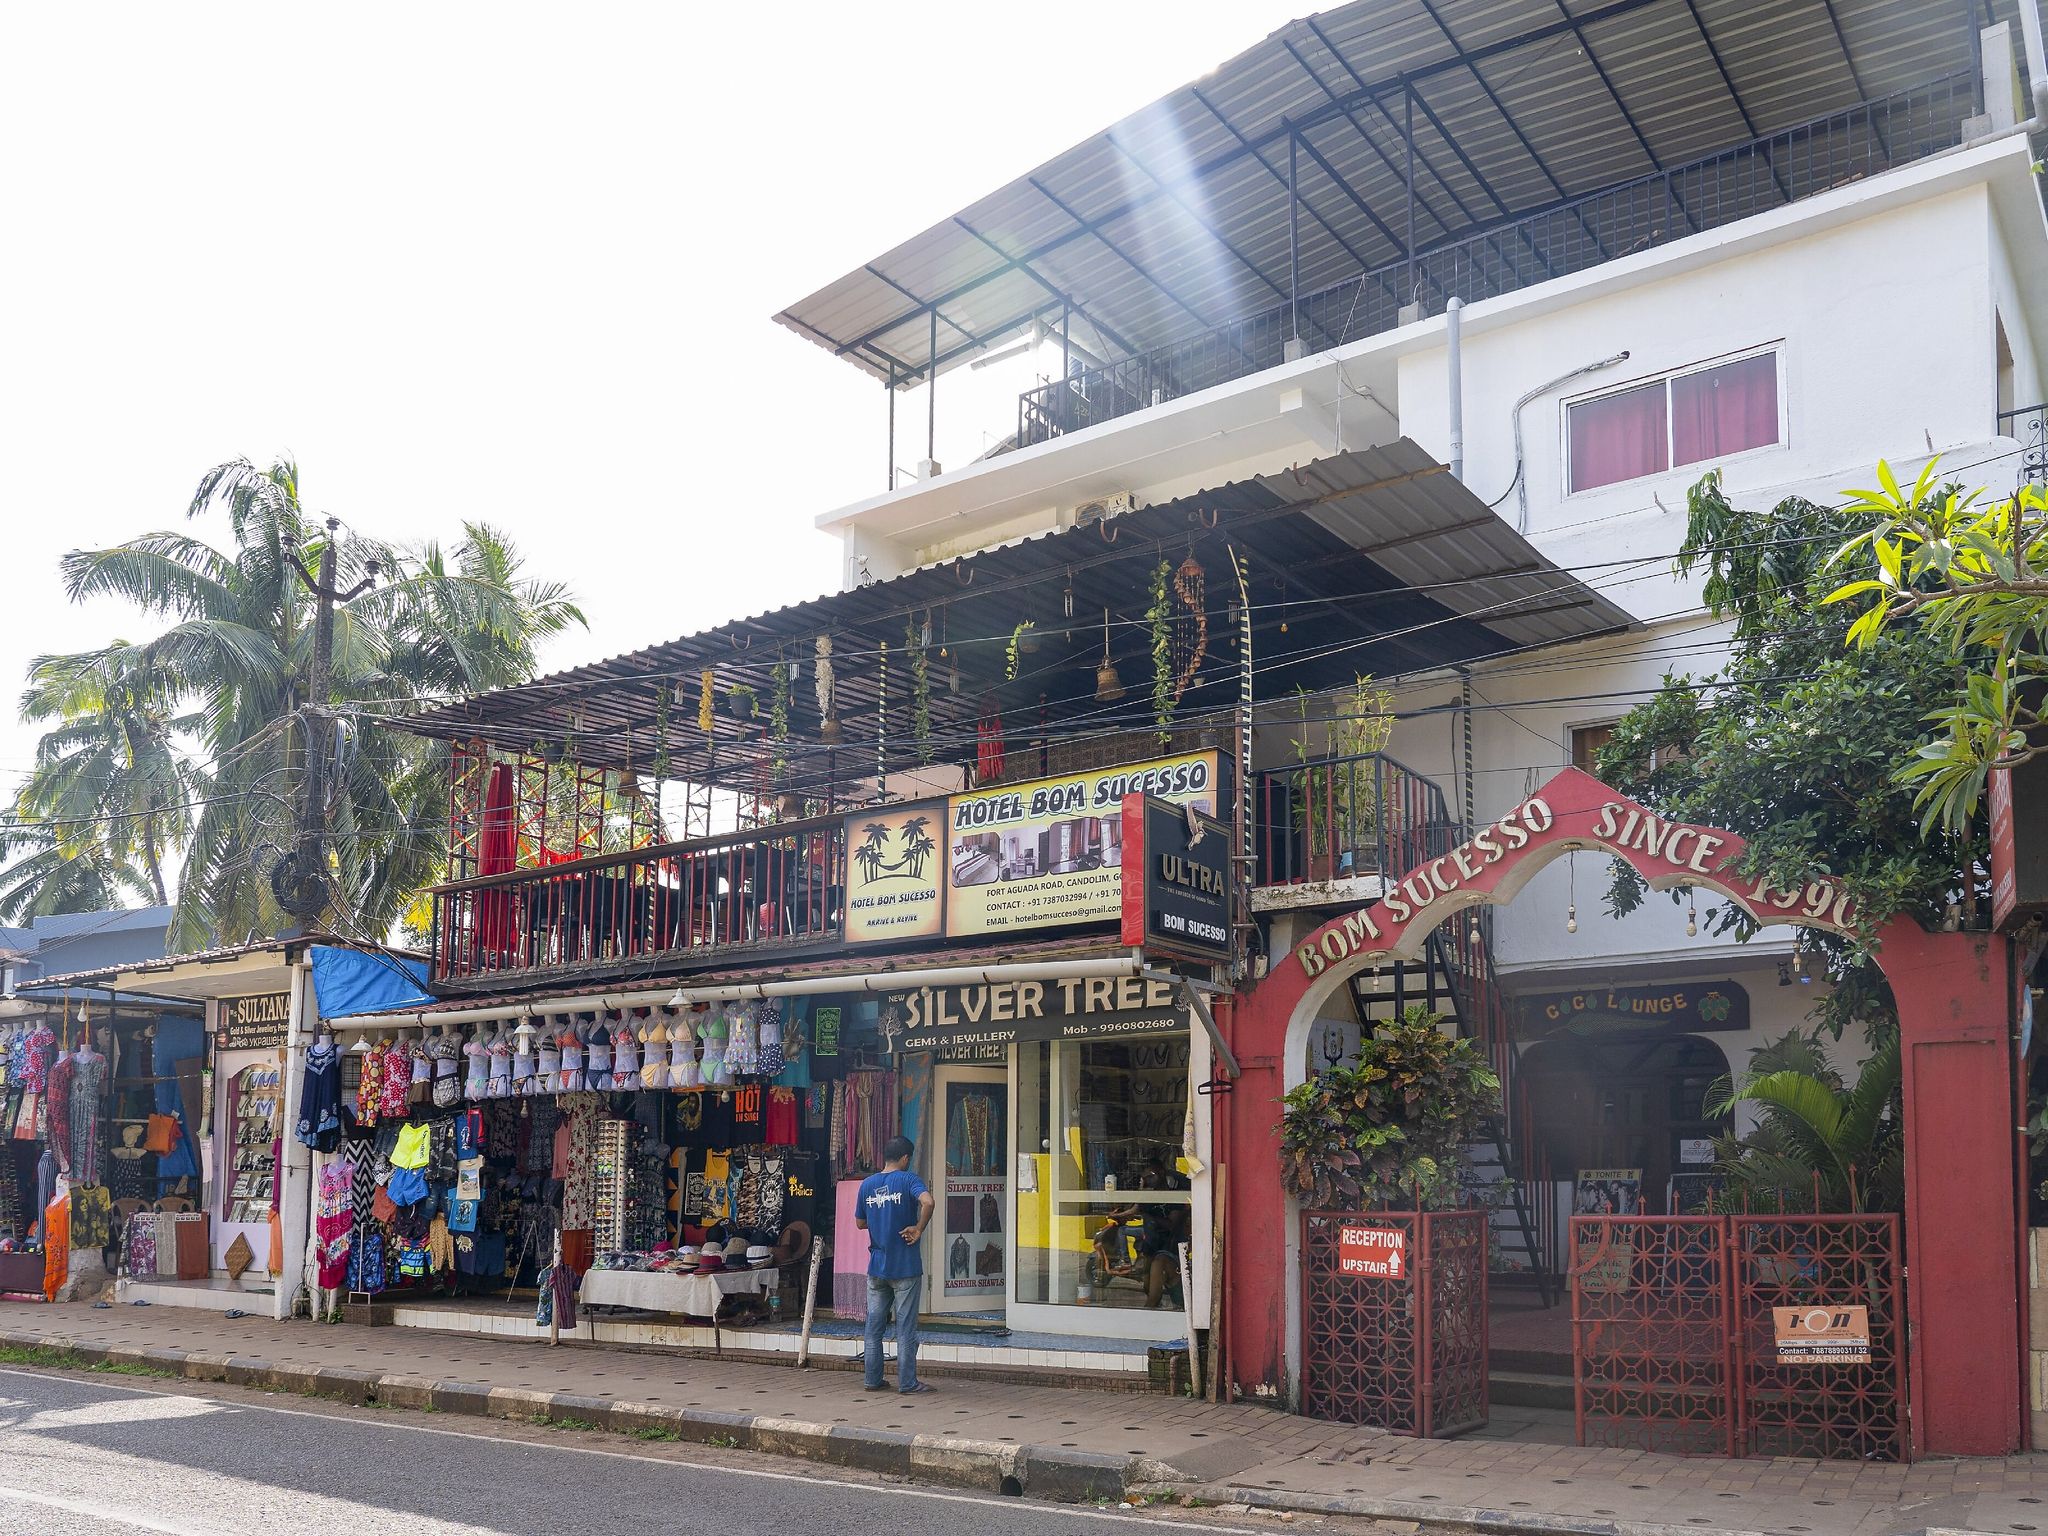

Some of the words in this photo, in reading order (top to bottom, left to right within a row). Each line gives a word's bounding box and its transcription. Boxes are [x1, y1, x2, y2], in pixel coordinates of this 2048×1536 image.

[954, 792, 1024, 831] HOTEL
[1029, 781, 1087, 818] BOM
[1092, 760, 1209, 806] SUCESSO
[1593, 802, 1724, 873] SINCE
[1162, 853, 1224, 897] ULTRA
[986, 888, 1006, 897] FORT
[1007, 884, 1039, 895] AGUADA
[1041, 881, 1065, 891] ROAD,
[1067, 874, 1111, 887] CANDOLIM,
[1297, 909, 1382, 977] BOM
[1383, 798, 1554, 923] SUCESSO
[850, 897, 875, 909] HOTEL
[877, 895, 896, 906] BOM
[899, 889, 936, 903] SUCESSO
[986, 901, 1020, 911] CONTACT
[1027, 898, 1041, 906] +91
[1043, 892, 1087, 905] 7387032994
[1095, 889, 1109, 898] +91
[866, 918, 889, 927] ARRIVE
[897, 914, 918, 923] REVIVE
[986, 917, 1008, 926] EMAIL
[1164, 914, 1185, 932] BOM
[1188, 920, 1226, 941] SUCESSO
[888, 995, 905, 1003] NEW
[905, 981, 1044, 1029] SILVER
[1057, 968, 1174, 1015] TREE
[237, 994, 291, 1024] SULTANA
[230, 1026, 240, 1035] Gold
[244, 1025, 256, 1034] Silver
[1063, 1025, 1088, 1035] Mob
[1100, 1018, 1175, 1032] 9960802680
[905, 1037, 937, 1047] GEMS
[940, 1036, 949, 1045] &
[952, 1030, 1016, 1045] JEWLLERY
[1594, 1171, 1623, 1179] TONITE
[947, 1183, 978, 1192] SILVER
[981, 1183, 1005, 1192] TREE
[1342, 1228, 1403, 1249] RECEPTION
[1342, 1258, 1388, 1274] UPSTAIR
[945, 1280, 977, 1289] KASHMIR
[978, 1278, 1005, 1288] SHAWLS
[1779, 1347, 1808, 1355] Contact:
[1858, 1346, 1867, 1354] 32
[1784, 1355, 1802, 1363] NO
[1806, 1355, 1864, 1363] PARKING
